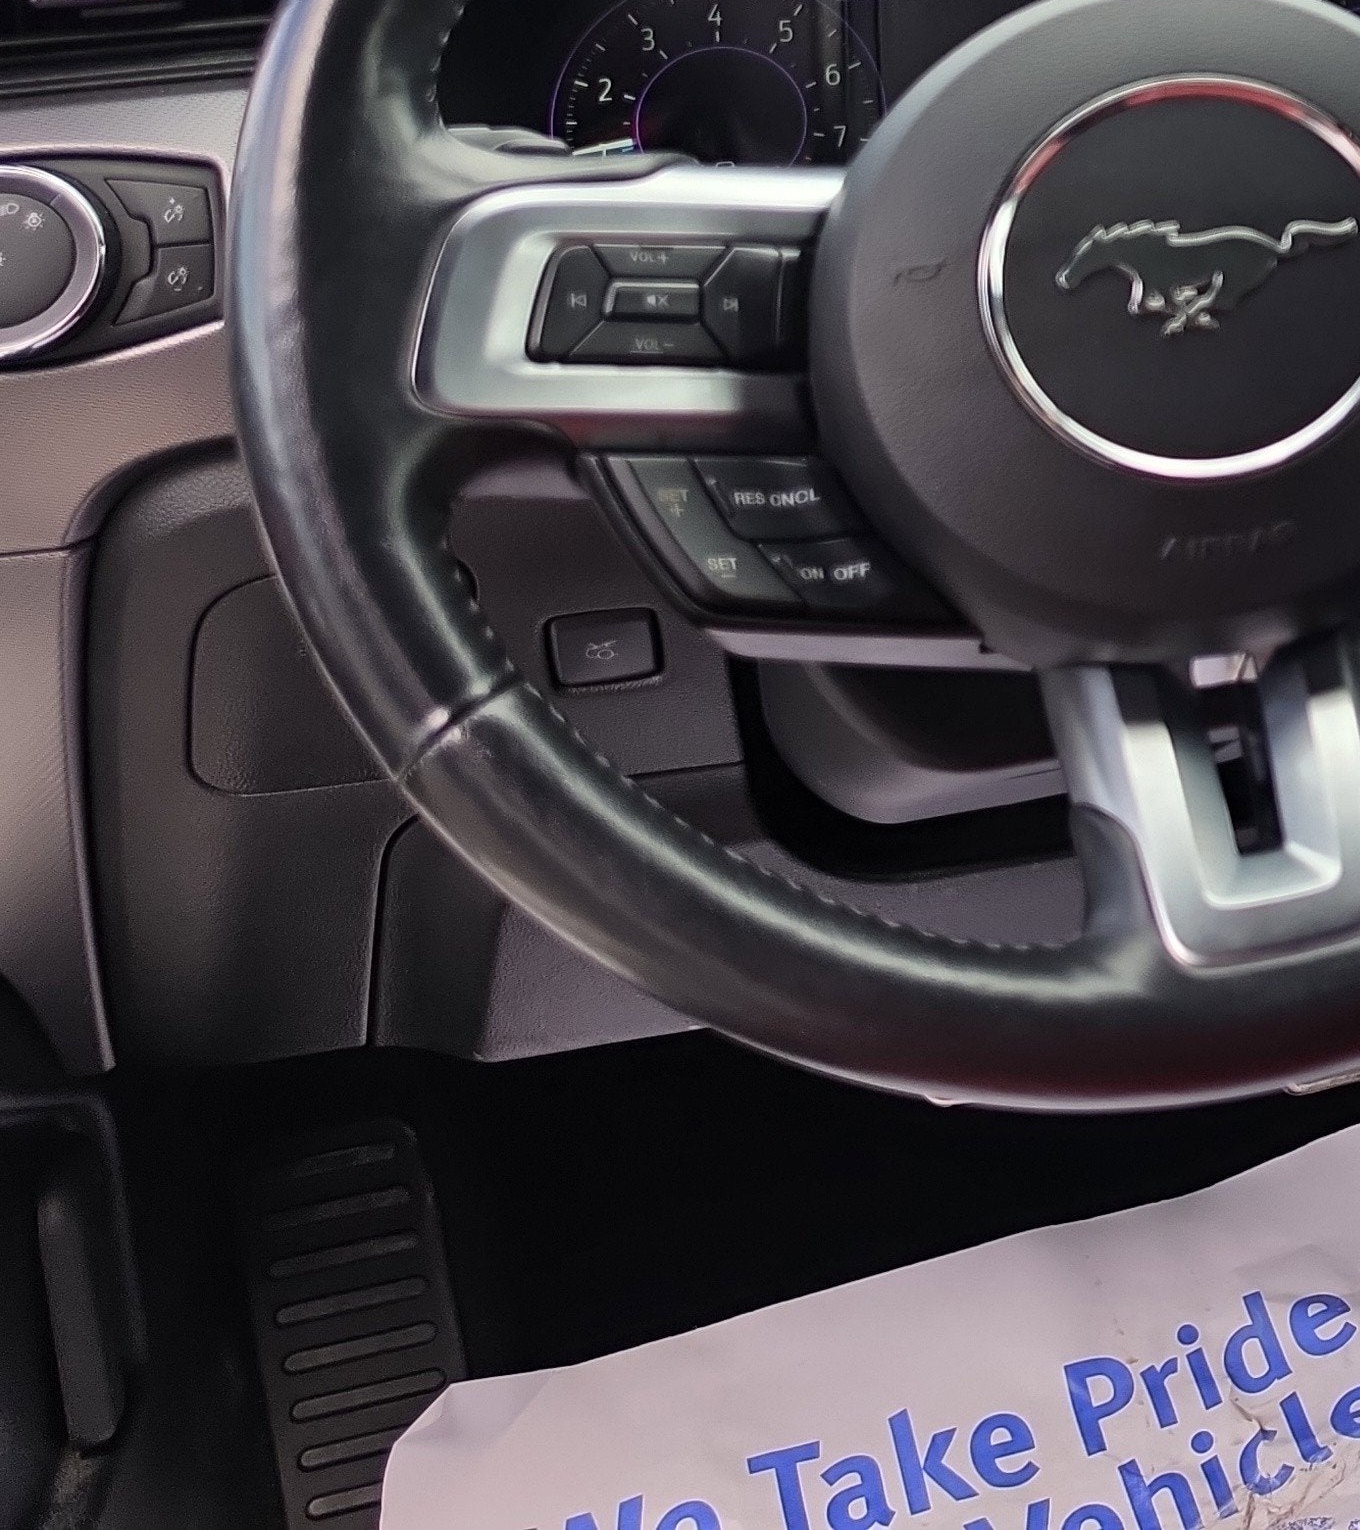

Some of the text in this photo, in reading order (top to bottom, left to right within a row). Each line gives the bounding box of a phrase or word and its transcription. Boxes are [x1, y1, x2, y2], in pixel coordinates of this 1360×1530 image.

[707, 5, 723, 26] 4
[642, 27, 655, 51] 3
[779, 20, 793, 42] 5
[824, 64, 841, 86] 6
[598, 79, 613, 102] 2
[834, 126, 847, 147] 7
[733, 490, 766, 505] RES
[707, 557, 738, 570] SET
[800, 562, 871, 581] ON OFF
[747, 1290, 1358, 1530] Take Pride
